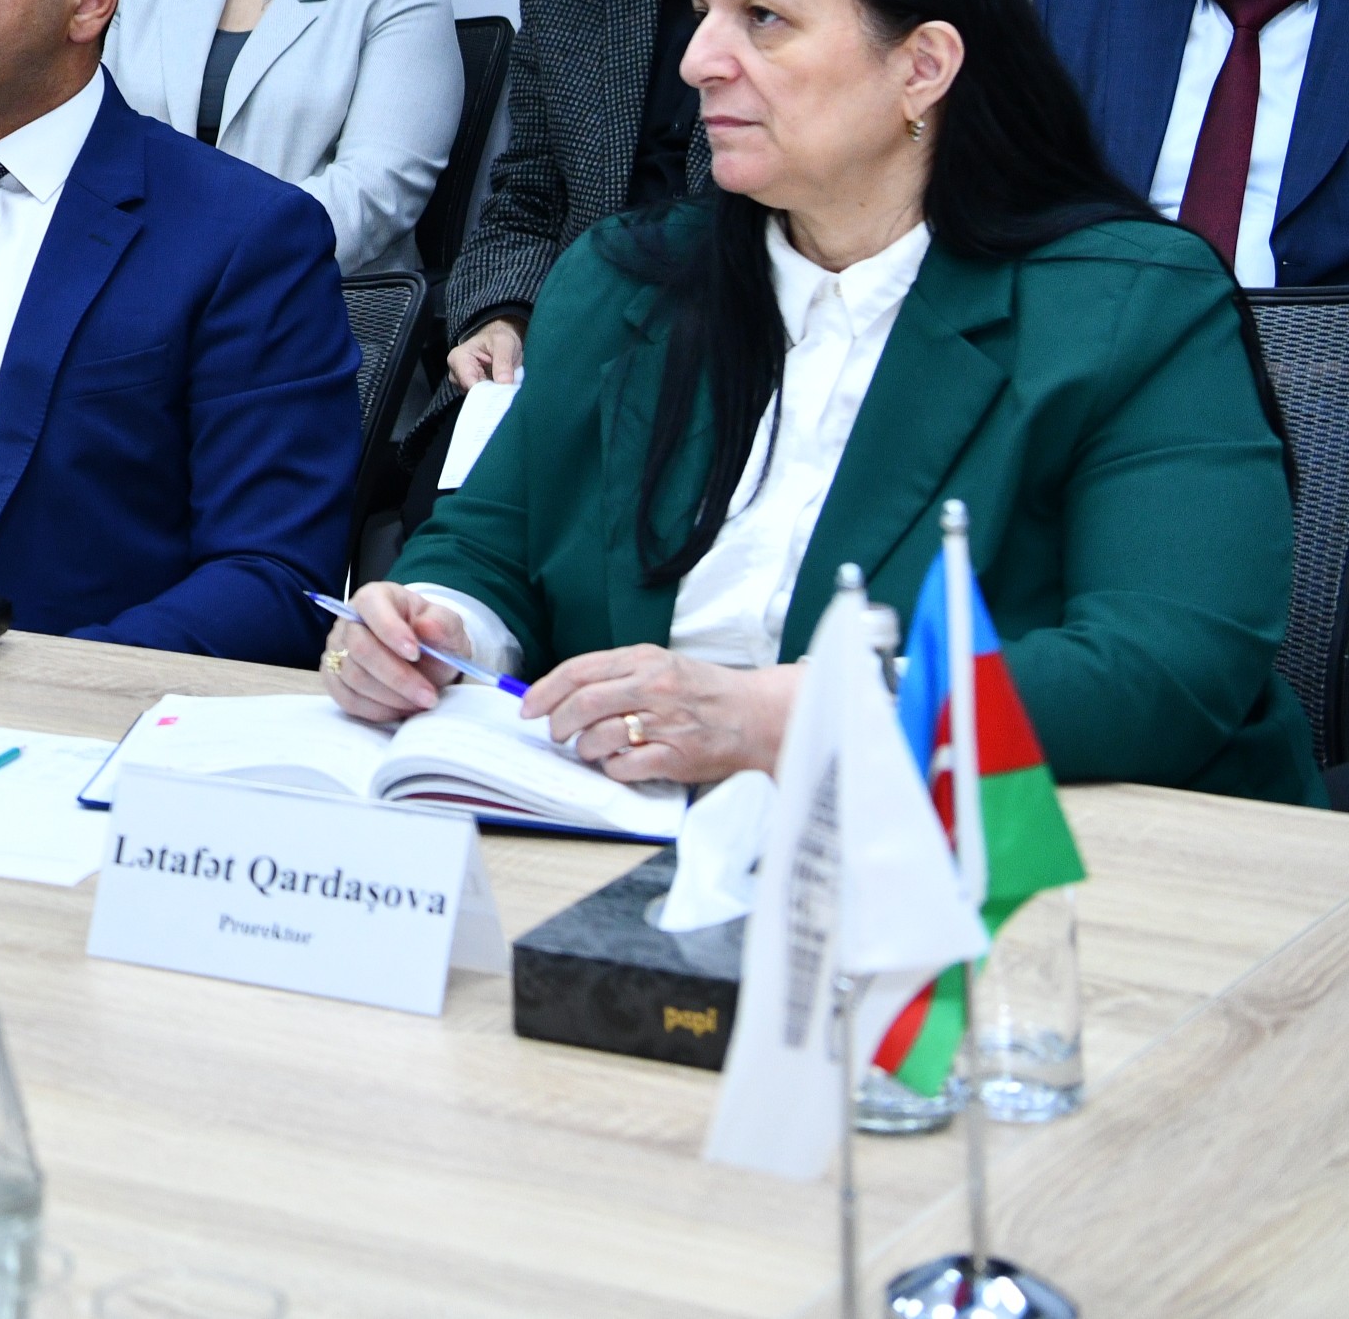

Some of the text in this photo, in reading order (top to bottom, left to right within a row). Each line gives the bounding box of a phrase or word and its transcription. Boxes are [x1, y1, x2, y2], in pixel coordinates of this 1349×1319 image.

[111, 834, 447, 916] Lətafət Qardaşova
[218, 913, 313, 945] Prorektor
[663, 1004, 718, 1038] papi
